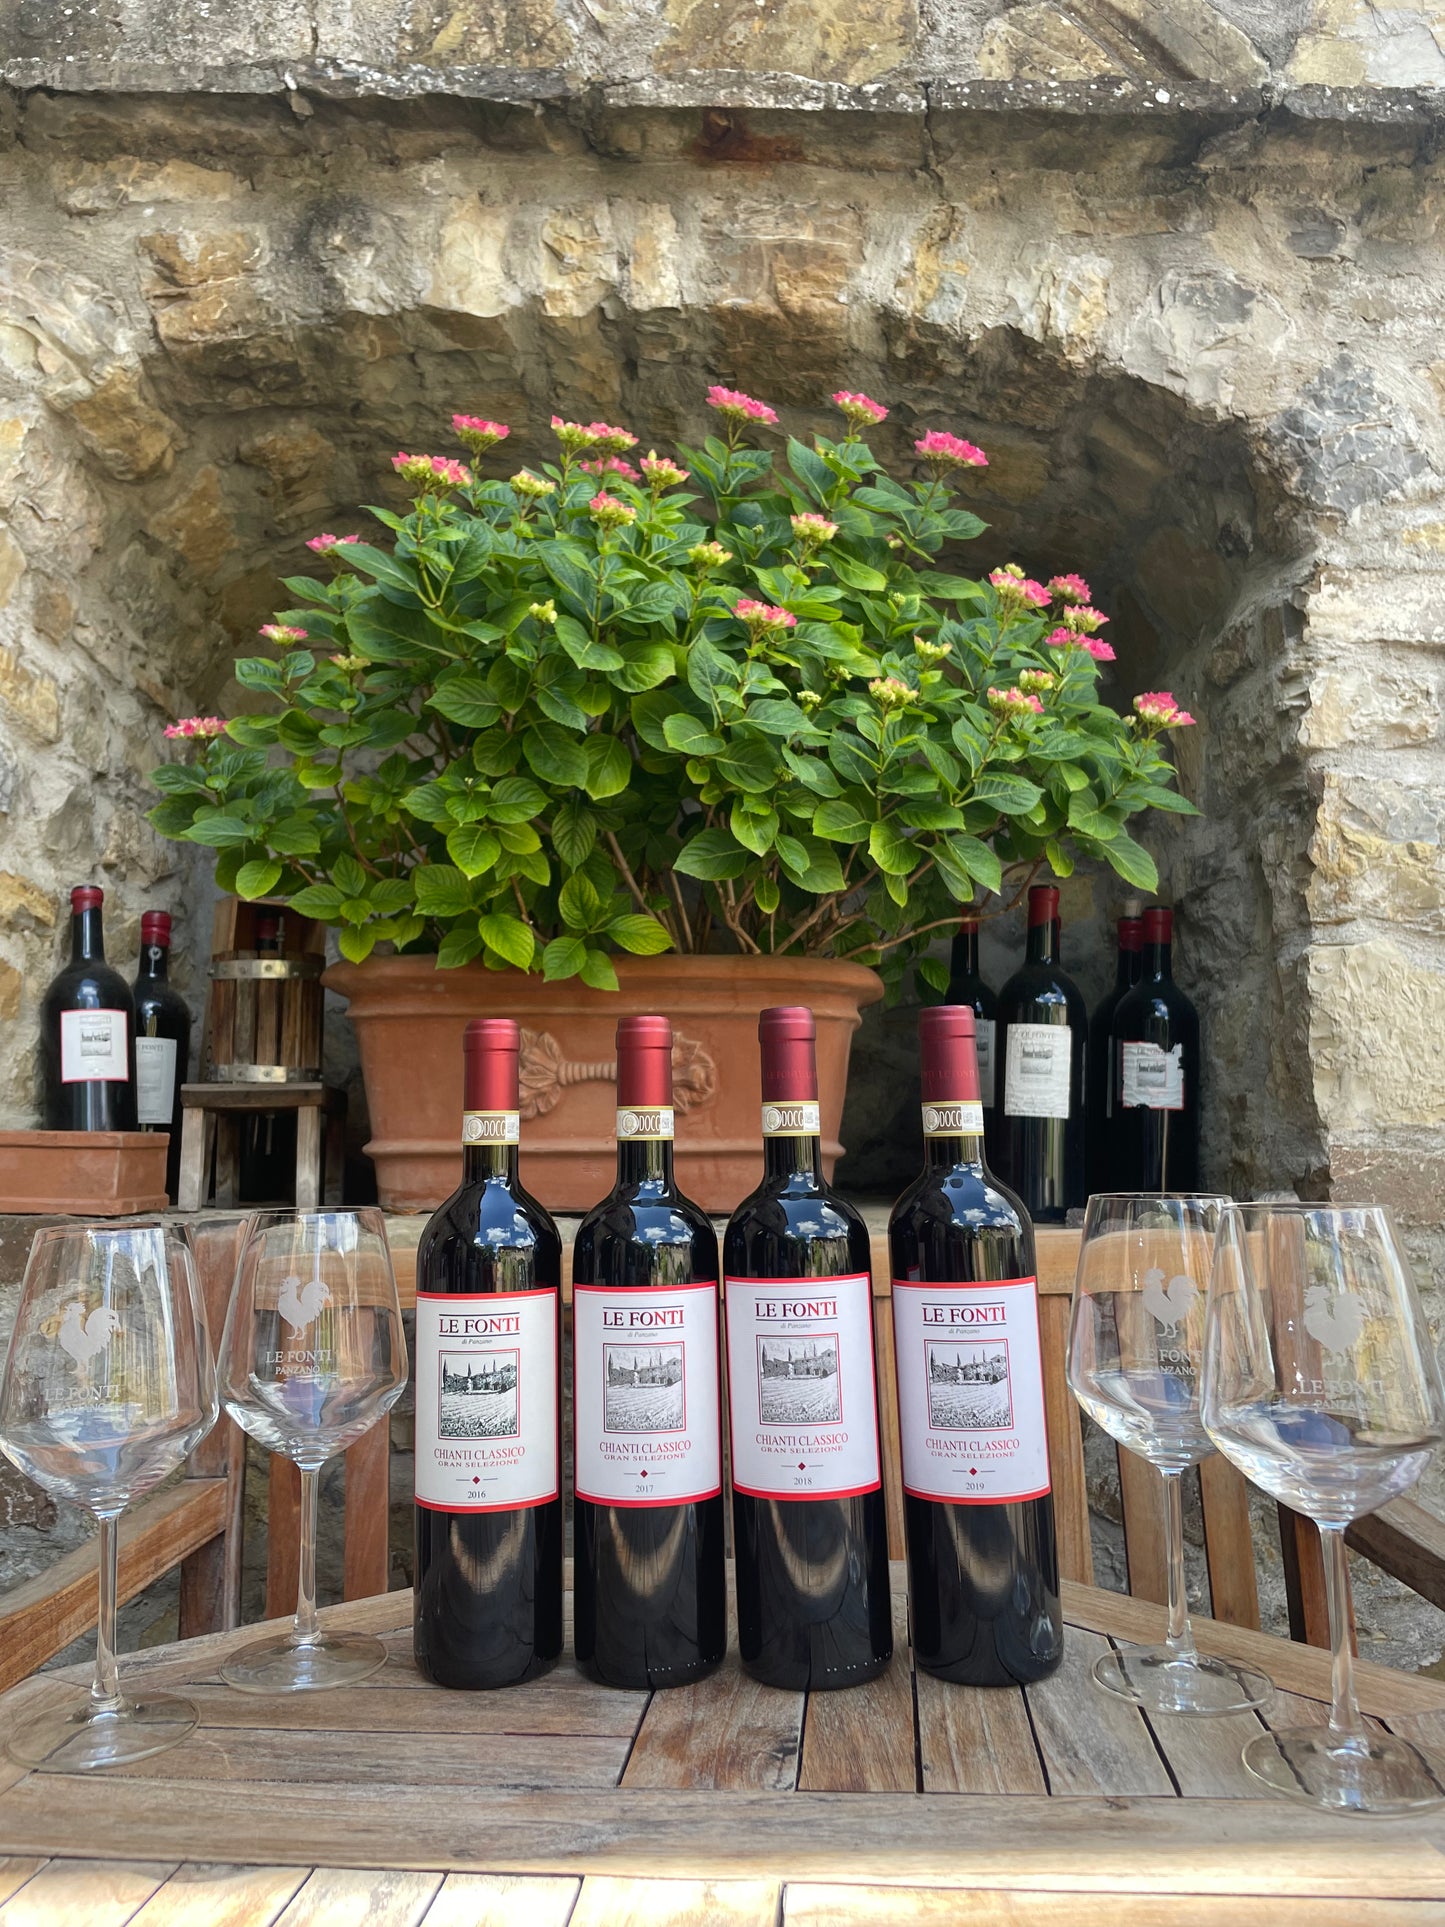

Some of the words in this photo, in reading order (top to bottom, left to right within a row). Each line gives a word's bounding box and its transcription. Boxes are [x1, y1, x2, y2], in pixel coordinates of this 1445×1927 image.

[781, 1110, 804, 1127] DOCG
[939, 1110, 962, 1127] DOCG
[755, 1302, 777, 1317] LE
[782, 1301, 838, 1317] FONTI
[922, 1307, 945, 1322] LE
[949, 1306, 1007, 1323] FONTI
[439, 1318, 459, 1333] LE
[464, 1316, 520, 1333] FONTI
[603, 1311, 624, 1326] LE
[629, 1309, 684, 1326] FONTI
[266, 1351, 284, 1363] LE
[287, 1349, 332, 1363] FONTI
[1159, 1349, 1203, 1363] FONT
[275, 1365, 320, 1375] PANZANO
[45, 1388, 64, 1401] LE
[67, 1384, 120, 1400] FONTI
[1299, 1380, 1324, 1394] LE
[756, 1433, 796, 1446] CHIANTI
[798, 1432, 849, 1446] CLASSICO
[926, 1438, 967, 1451] CHIANTI
[969, 1438, 1020, 1452] CLASSICO
[434, 1448, 472, 1460] CHIANTI
[474, 1446, 525, 1460] CLASSICO
[599, 1441, 639, 1454] CHIANTI
[641, 1439, 691, 1454] CLASSICO
[761, 1446, 787, 1454] GRAN
[790, 1445, 844, 1454] SELEZIONE
[632, 1452, 686, 1462] SELEZIONE
[931, 1450, 957, 1458] GRAN
[960, 1451, 1015, 1459] SELEZIONE
[438, 1460, 462, 1468] GRAN
[465, 1458, 519, 1468] SELEZIONE
[793, 1476, 813, 1486] 2018
[966, 1481, 985, 1491] 2019
[467, 1490, 486, 1499] 2016
[635, 1484, 654, 1493] 2017
